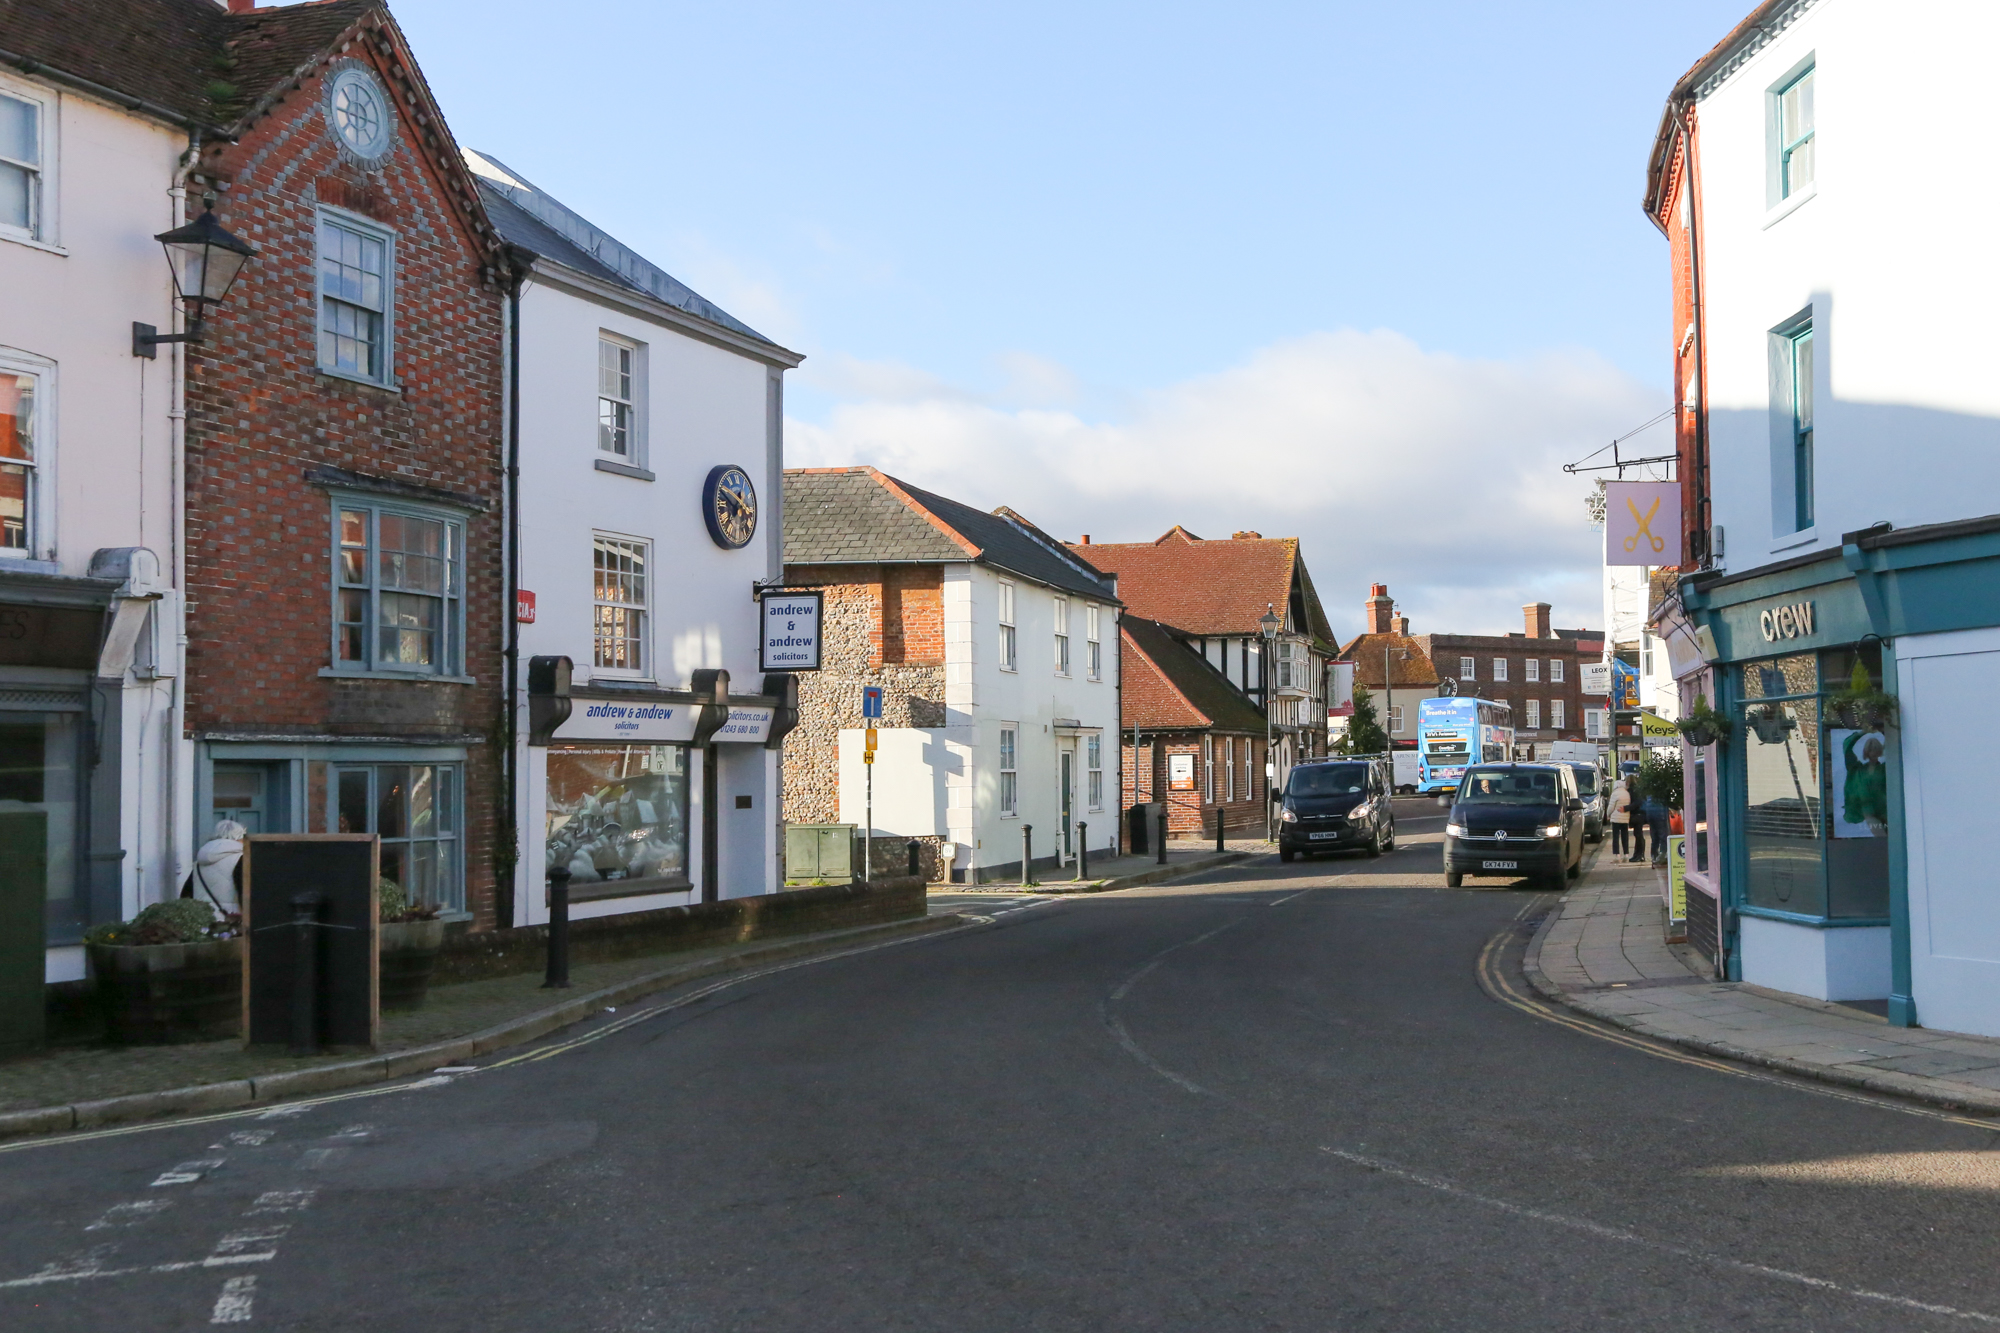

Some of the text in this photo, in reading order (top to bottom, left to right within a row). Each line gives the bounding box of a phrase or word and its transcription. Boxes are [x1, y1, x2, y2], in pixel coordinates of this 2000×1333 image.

[769, 603, 814, 616] andrew
[787, 620, 796, 631] &
[1760, 601, 1813, 642] crew
[769, 635, 813, 647] andrew
[772, 652, 809, 661] solicitors
[586, 702, 674, 720] andrew & andrew
[614, 721, 640, 730] solicitors
[737, 725, 749, 734] 680
[1645, 725, 1675, 736] Keys
